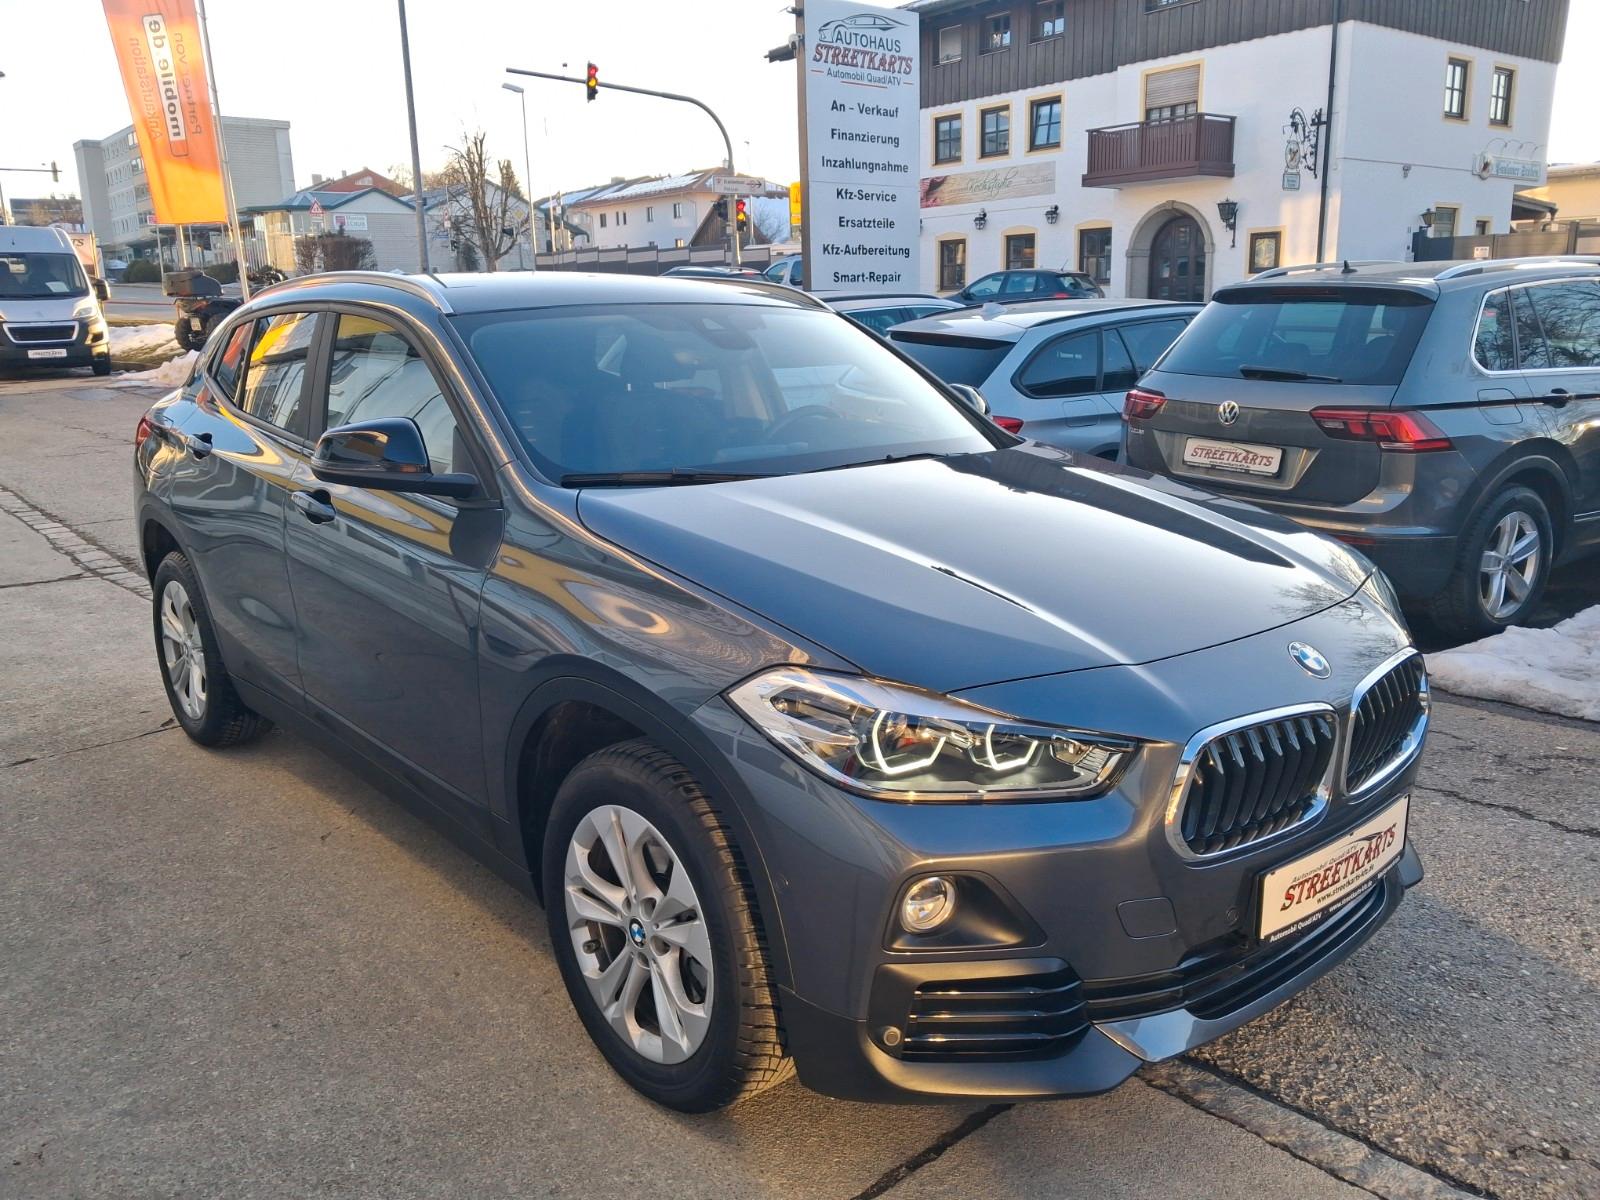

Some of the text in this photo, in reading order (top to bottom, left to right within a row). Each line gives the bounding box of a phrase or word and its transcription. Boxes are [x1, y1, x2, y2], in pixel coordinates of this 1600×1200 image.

[835, 31, 901, 53] AUTOHAUS
[813, 43, 913, 75] STREETKARTS
[827, 67, 902, 86] Automobil Quad/ATV
[830, 100, 846, 112] An
[857, 103, 899, 118] Verkauf
[830, 128, 900, 148] Finanzierung
[821, 156, 909, 173] Inzahlungnahme
[836, 187, 897, 202] Kfz-Service
[838, 216, 895, 229] Ersatzteile
[822, 243, 910, 258] Kfz-Aufbereitung
[833, 271, 901, 284] Smart-Repair
[1191, 447, 1274, 467] STREETKARTS
[1280, 823, 1398, 912] STREETKARTS
[1269, 924, 1298, 943] Automobil
